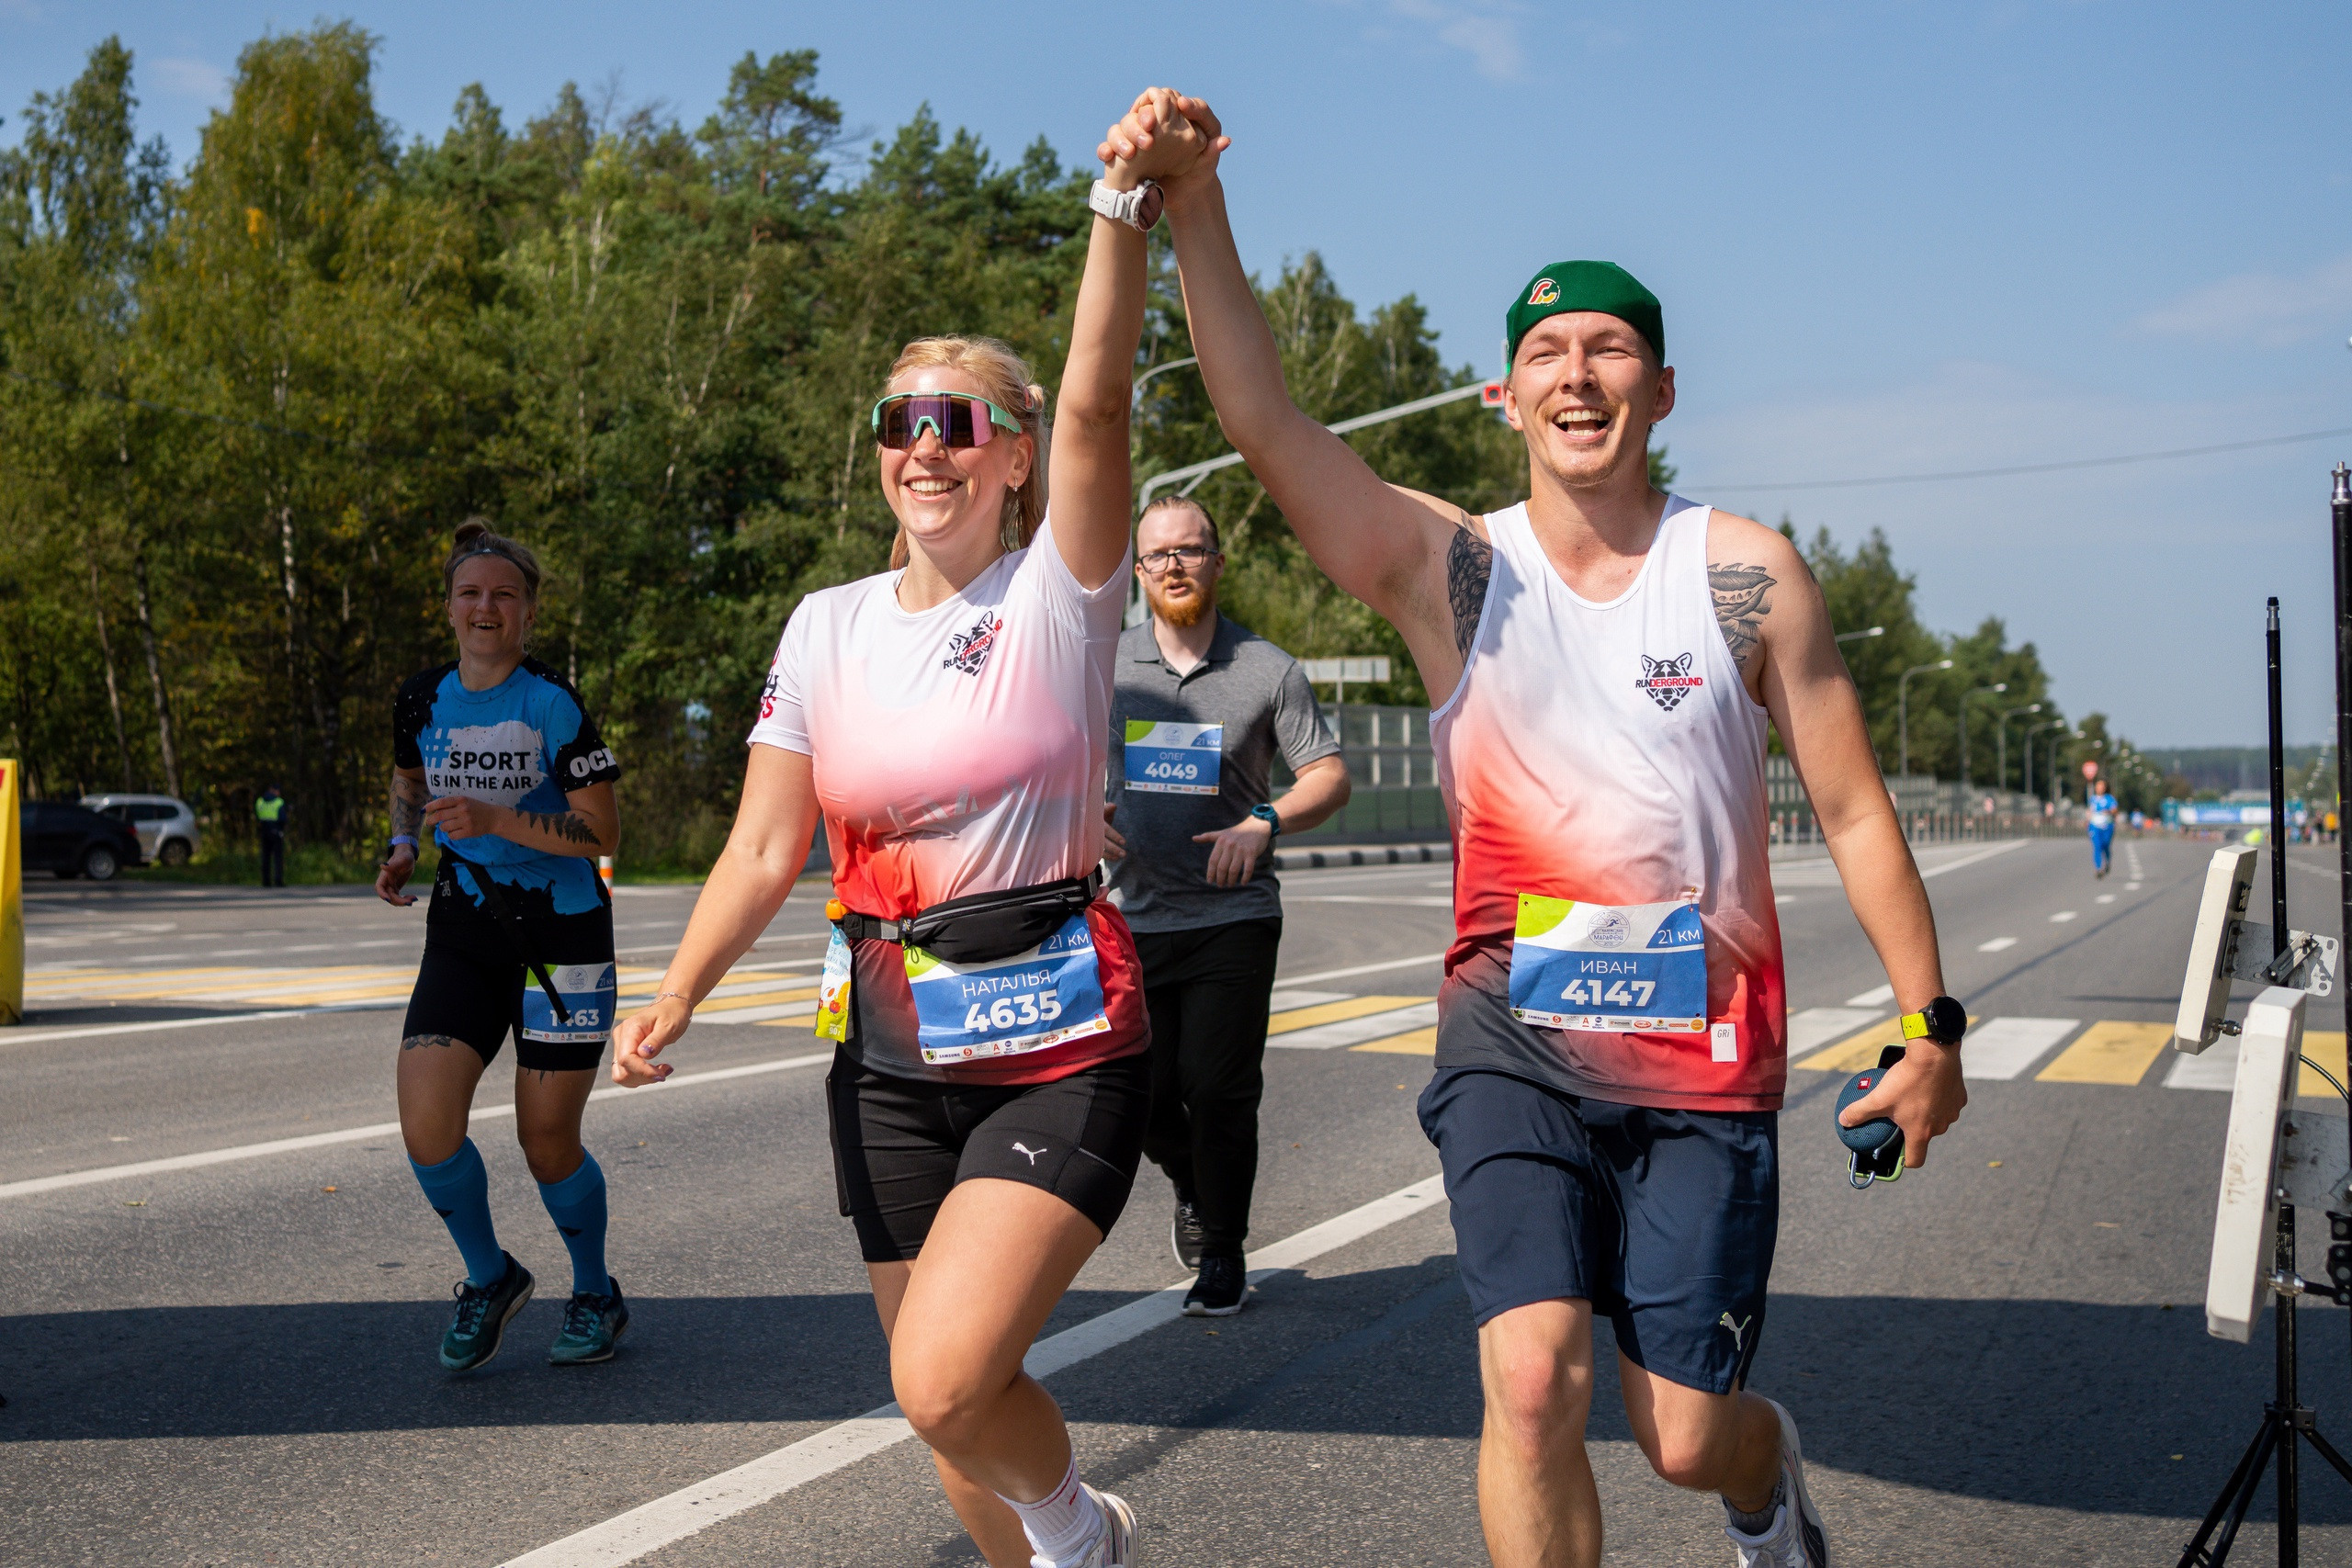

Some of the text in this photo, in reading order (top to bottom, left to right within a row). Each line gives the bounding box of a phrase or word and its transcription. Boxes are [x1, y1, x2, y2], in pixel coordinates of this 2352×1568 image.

[1635, 677, 1703, 688] RUNDERGROUND
[1196, 738, 1205, 746] 21
[1159, 751, 1186, 761] ОЛЕГ
[1145, 761, 1198, 780] 4049
[431, 774, 533, 790] IS IN THE AIR
[1048, 935, 1062, 950] 21
[1657, 930, 1673, 944] 21
[1580, 960, 1637, 975] ИВАН
[599, 977, 606, 987] 21
[962, 969, 1051, 998] НАТАЛЬЯ
[1561, 979, 1657, 1008] 4147
[964, 988, 1062, 1032] 4635
[1717, 1029, 1730, 1039] GRi
